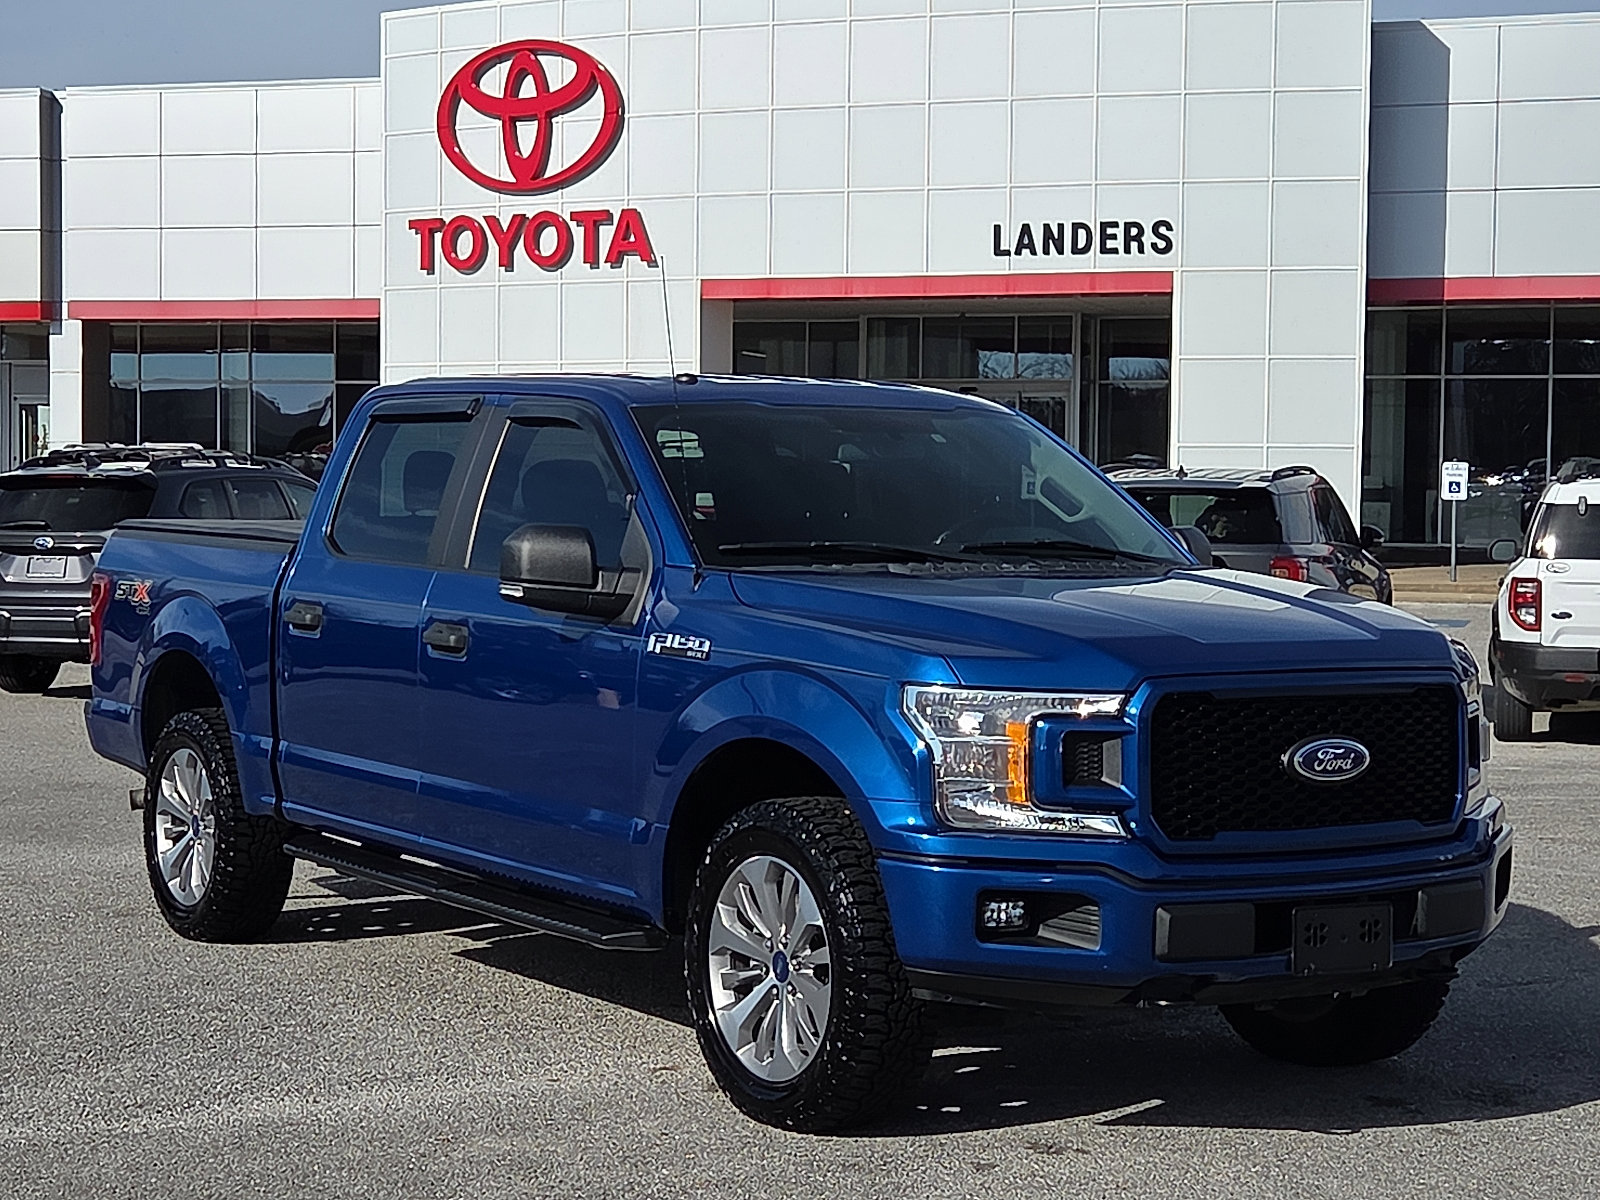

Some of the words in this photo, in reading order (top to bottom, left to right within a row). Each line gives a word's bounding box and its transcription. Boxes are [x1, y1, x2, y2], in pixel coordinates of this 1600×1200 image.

[408, 208, 659, 275] TOYOTA
[993, 219, 1174, 256] LANDERS
[114, 580, 153, 606] STX
[1313, 748, 1354, 771] Ford
